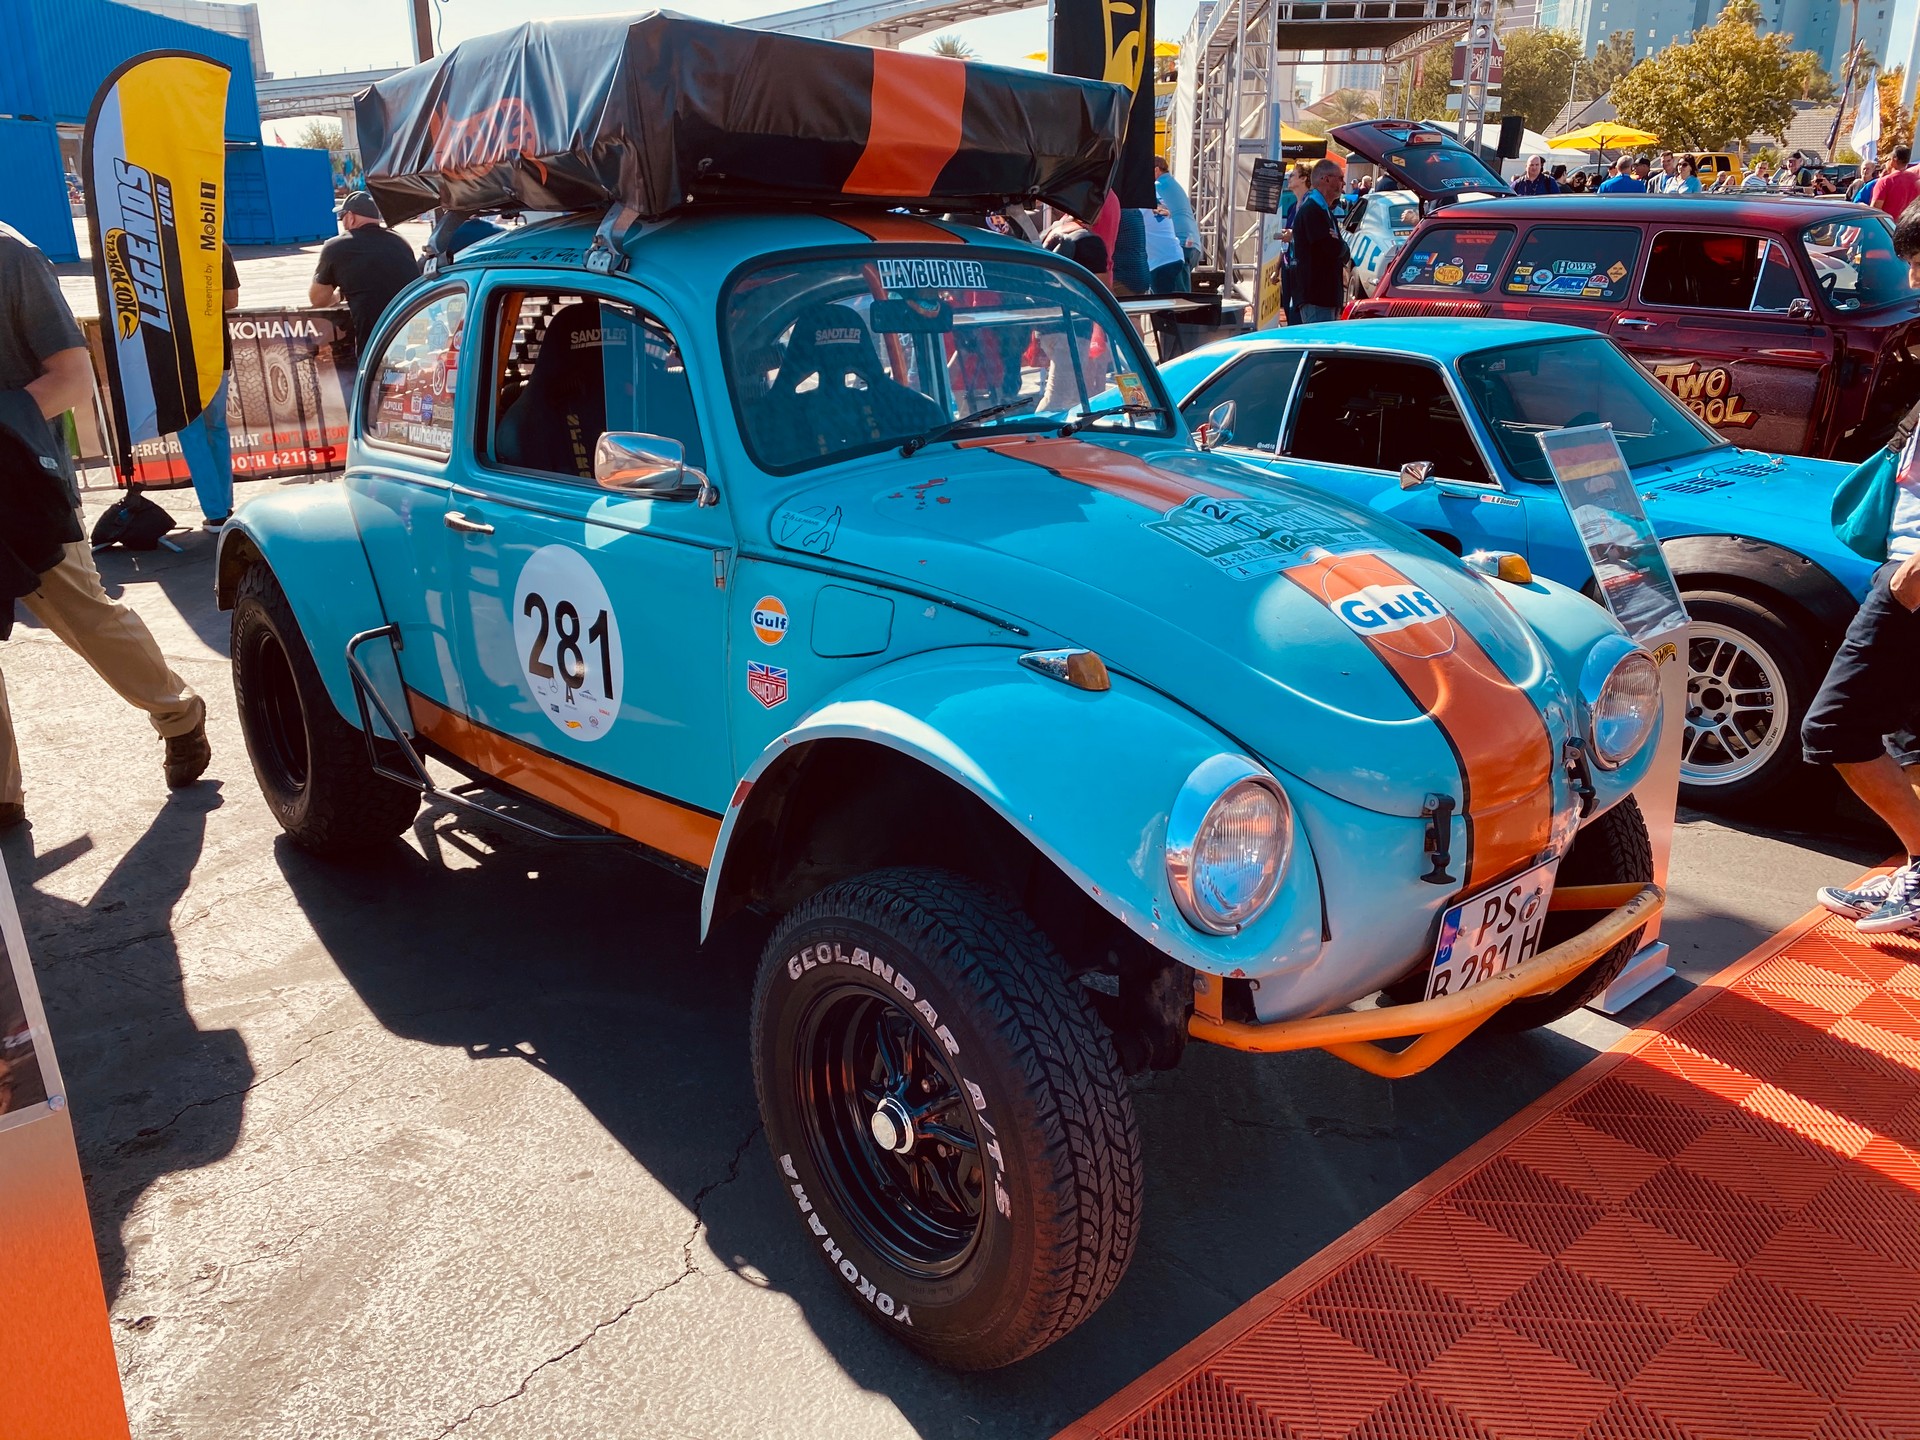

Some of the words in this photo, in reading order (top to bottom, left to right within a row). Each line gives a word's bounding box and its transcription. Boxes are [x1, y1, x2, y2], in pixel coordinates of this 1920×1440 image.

[157, 183, 174, 228] TOUR
[200, 202, 217, 251] Mobil
[113, 157, 171, 333] LEGENDS
[205, 263, 214, 274] by
[877, 260, 988, 289] HAYBURNER
[1467, 272, 1490, 281] MSD
[204, 275, 212, 317] Presented
[230, 320, 318, 340] KOHAMA
[571, 328, 627, 344] SANDTLER
[815, 328, 861, 341] SANDTLER
[1654, 362, 1726, 400] TWO
[1691, 396, 1752, 425] OOL
[230, 433, 259, 449] THAT
[262, 431, 299, 444] CAN'T
[324, 426, 348, 439] CON
[272, 450, 318, 466] 62118
[753, 611, 787, 630] Gulf
[1339, 591, 1441, 629] Gulf
[523, 592, 614, 701] 281
[565, 683, 575, 705] A
[1475, 885, 1522, 947] PS
[1441, 945, 1449, 959] D
[787, 942, 960, 1056] GEOLANDAR
[779, 1153, 914, 1327] YOKOHAMA
